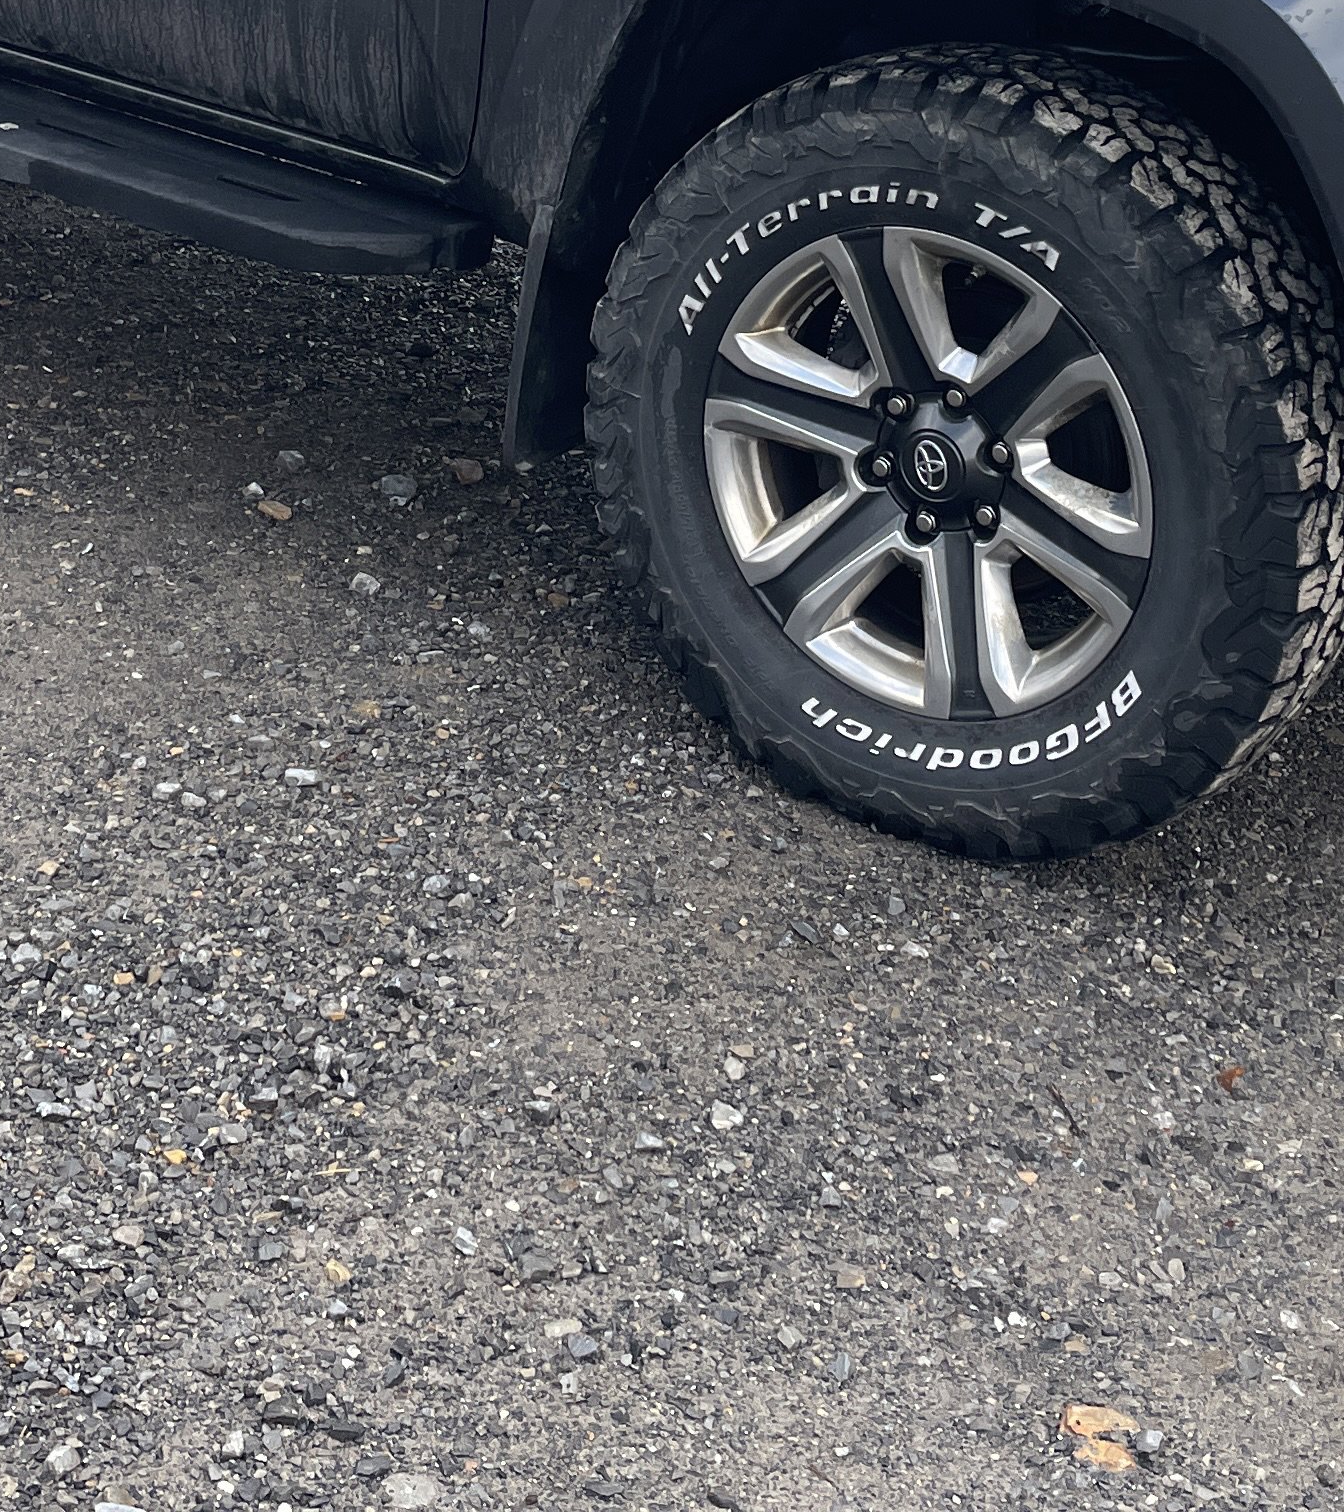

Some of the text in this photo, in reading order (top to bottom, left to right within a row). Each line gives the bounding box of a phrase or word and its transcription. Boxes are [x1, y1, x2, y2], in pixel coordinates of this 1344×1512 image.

[678, 182, 940, 336] All-Terrain
[974, 202, 1060, 272] T/A
[801, 670, 1143, 771] BFGoodrich
